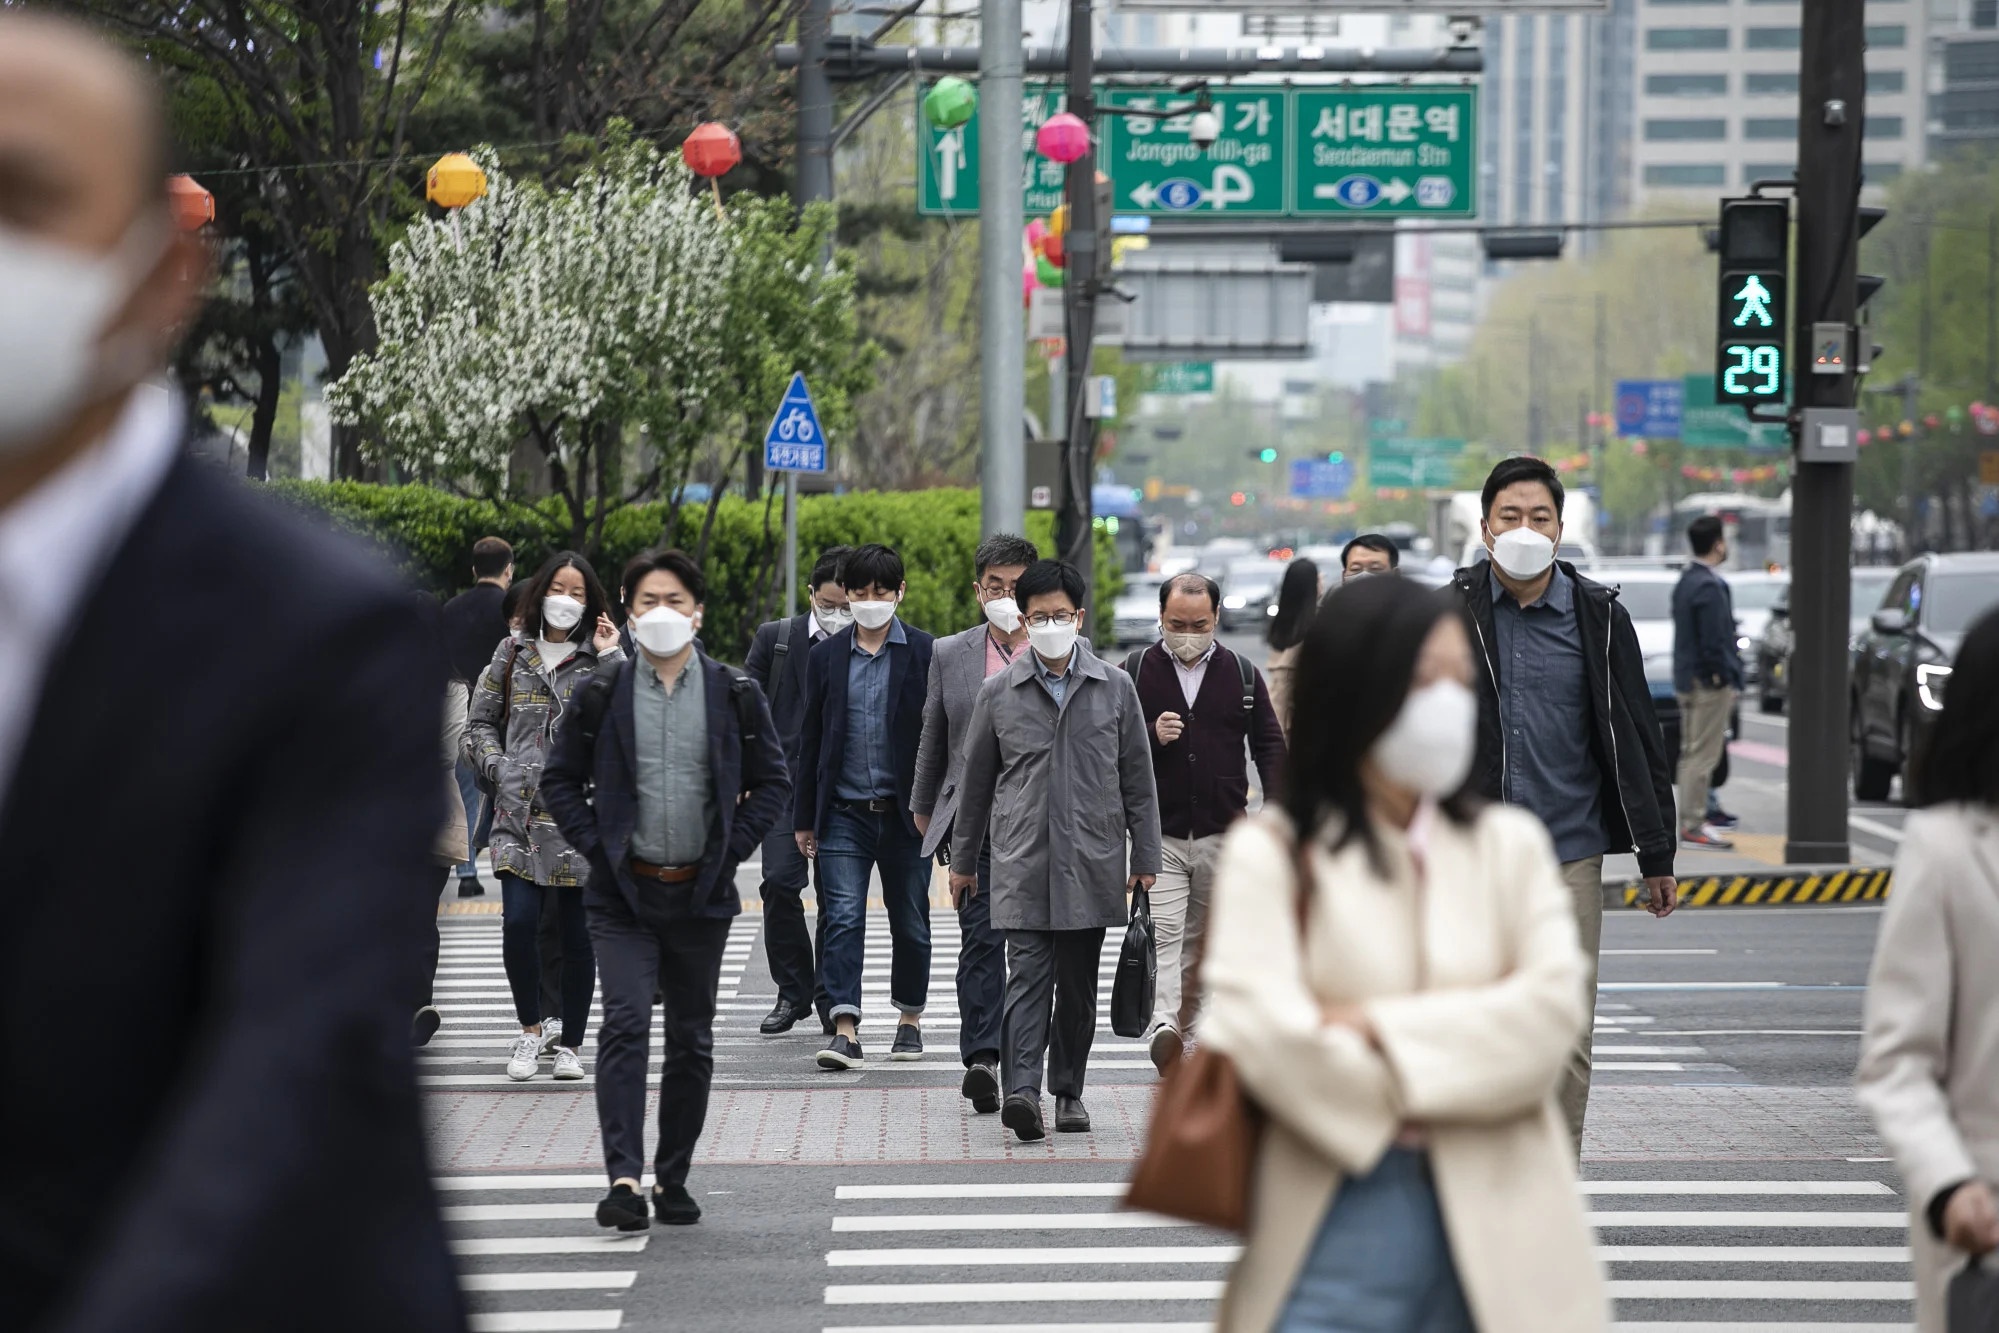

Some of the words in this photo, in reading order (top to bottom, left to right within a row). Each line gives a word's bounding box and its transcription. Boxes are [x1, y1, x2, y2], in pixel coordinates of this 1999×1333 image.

[1311, 103, 1460, 142] 서대문역
[1125, 138, 1200, 167] Jongno
[1313, 142, 1416, 167] Seodaemun
[1417, 142, 1451, 167] Stn
[1169, 182, 1190, 207] 6
[1349, 180, 1370, 204] 6
[1724, 345, 1779, 394] 29
